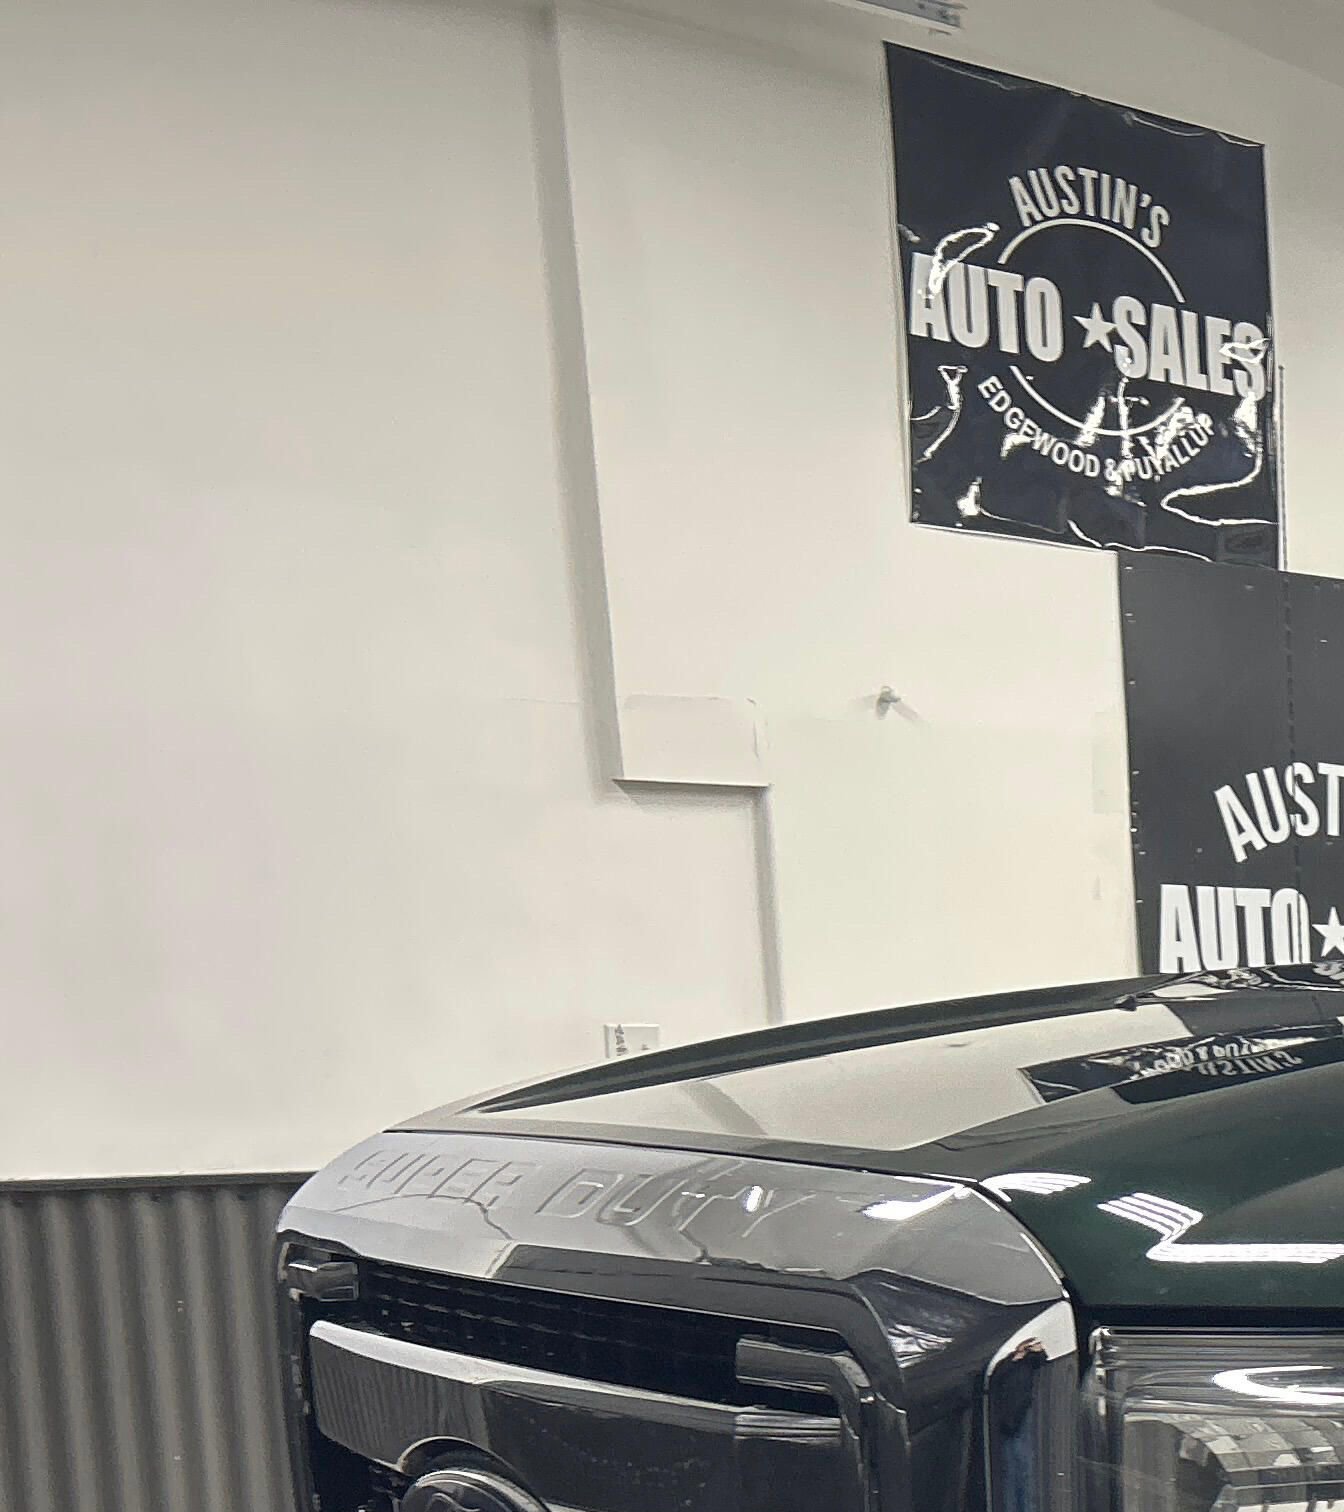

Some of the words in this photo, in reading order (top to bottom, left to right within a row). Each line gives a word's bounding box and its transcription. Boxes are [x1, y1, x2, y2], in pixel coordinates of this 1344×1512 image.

[1009, 165, 1169, 249] AUSTIN'S
[910, 251, 1064, 362] AUTO
[1112, 295, 1266, 401] SALES
[977, 376, 1100, 478] EDGEWOOD
[1159, 884, 1311, 974] AUTO
[336, 1149, 541, 1207] SUPER
[536, 1160, 817, 1239] DUTY
